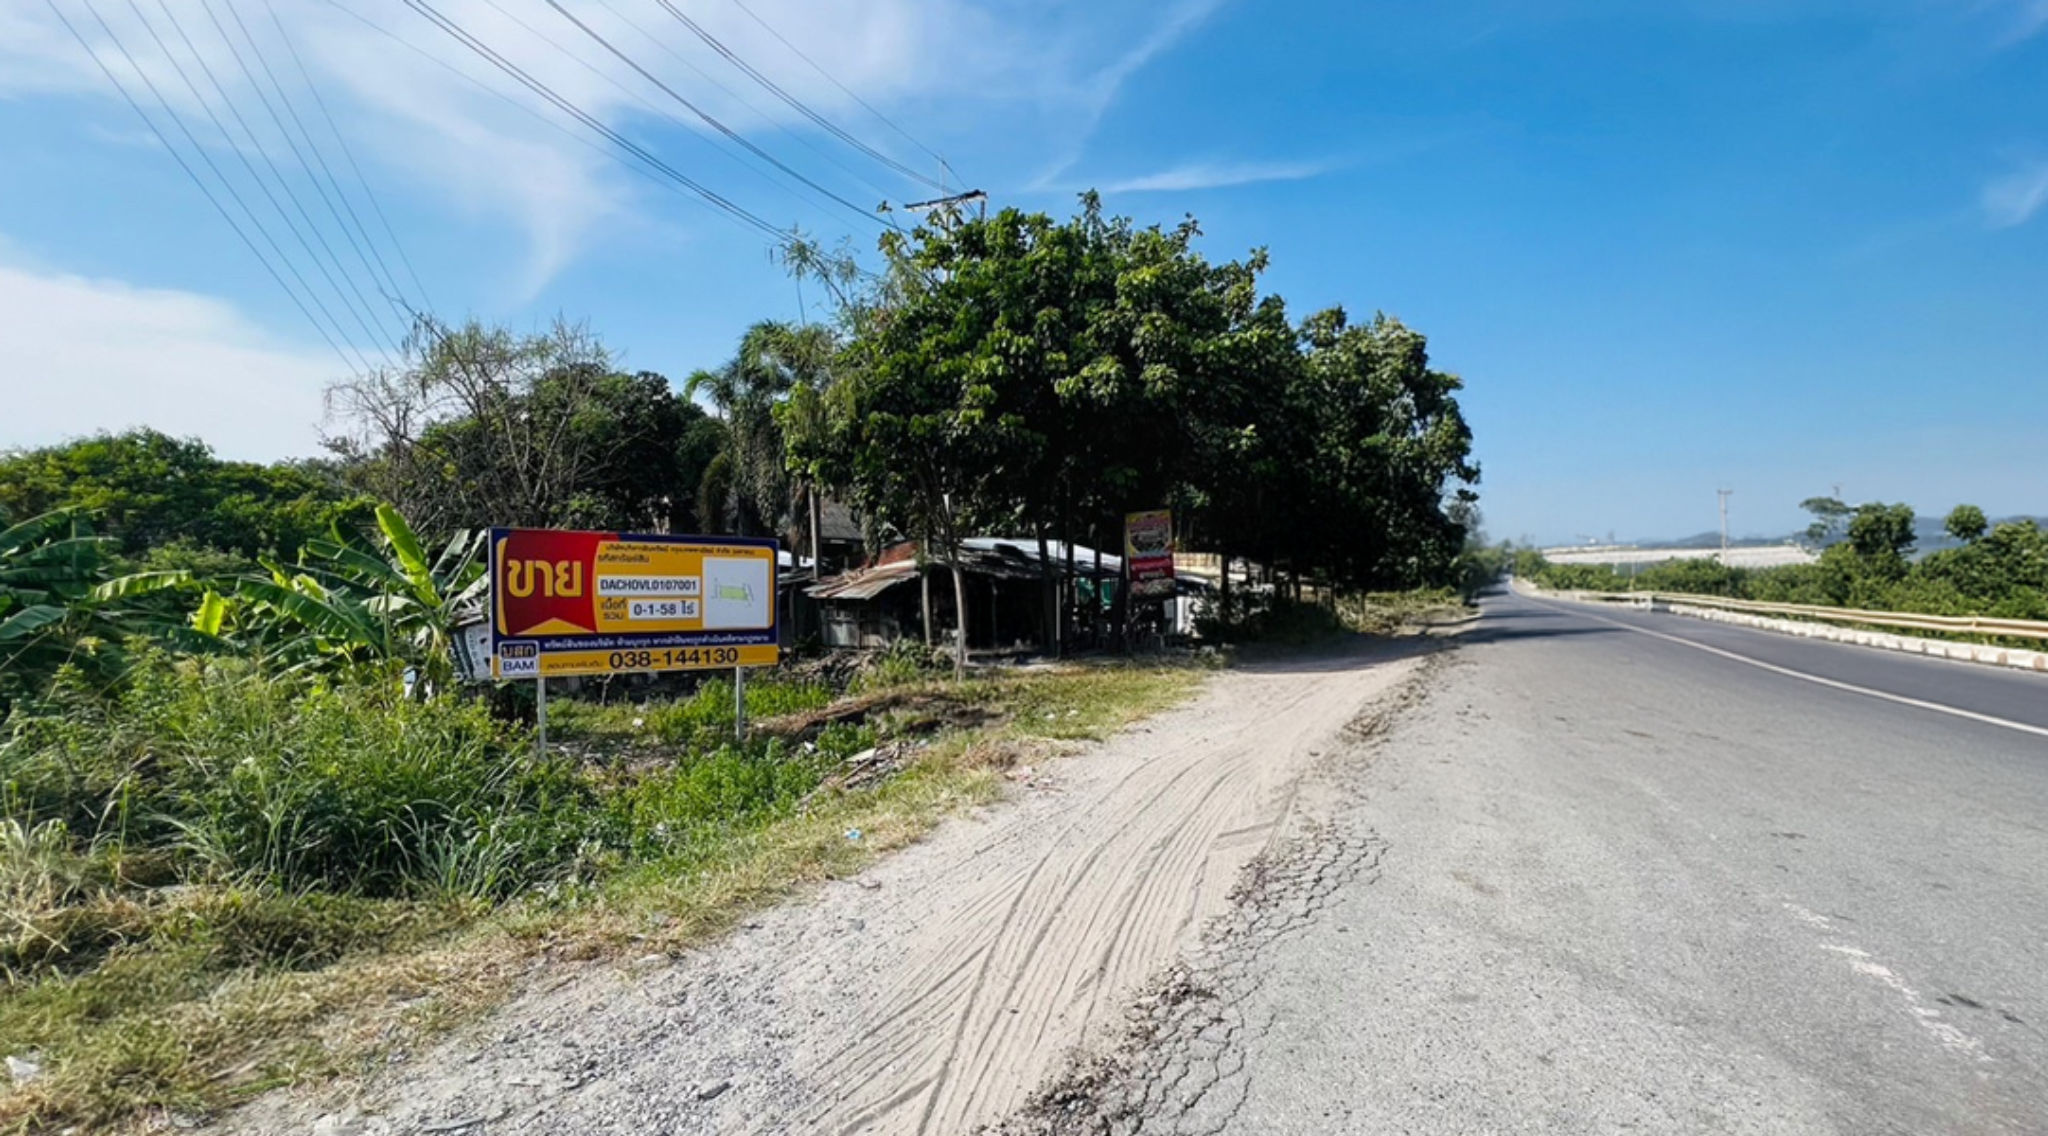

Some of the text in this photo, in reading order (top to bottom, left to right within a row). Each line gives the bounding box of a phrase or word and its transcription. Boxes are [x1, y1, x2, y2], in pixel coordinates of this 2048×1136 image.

[507, 560, 582, 597] ขาย
[633, 603, 677, 616] 0-1-58
[502, 660, 535, 672] BAM
[609, 647, 739, 669] 038-144130
